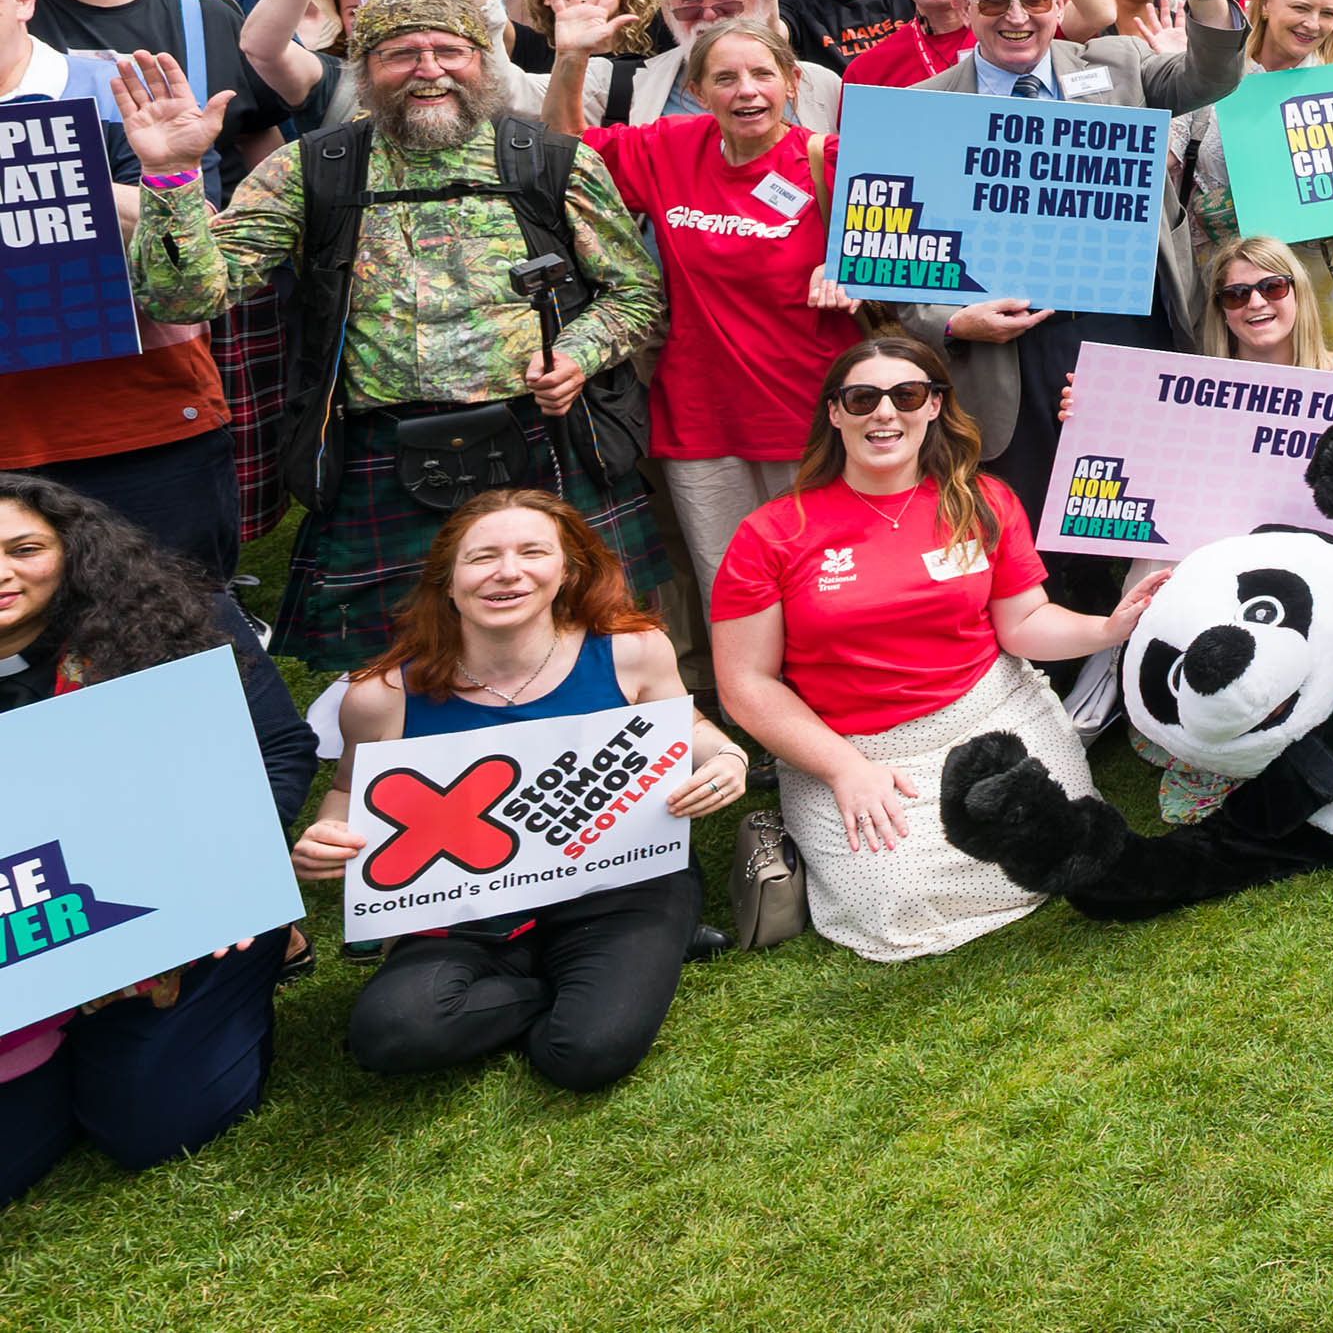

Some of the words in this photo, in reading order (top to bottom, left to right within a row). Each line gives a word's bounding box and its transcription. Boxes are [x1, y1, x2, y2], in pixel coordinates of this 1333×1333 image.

[989, 114, 1043, 146] FOR
[1052, 119, 1156, 154] PEOPLE
[965, 147, 1019, 178] FOR
[1030, 151, 1152, 188] CLIMATE
[849, 179, 905, 207] ACT
[974, 183, 1028, 215] FOR
[1039, 186, 1149, 223] NATURE
[666, 206, 799, 238] GREENPEACE
[846, 205, 912, 232] NOW
[842, 230, 952, 262] CHANGE
[840, 257, 960, 289] FOREVER
[818, 574, 857, 585] National
[818, 583, 840, 592] Trust
[564, 741, 689, 859] SCOTLAND
[489, 864, 577, 891] climate
[585, 840, 681, 873] coalition
